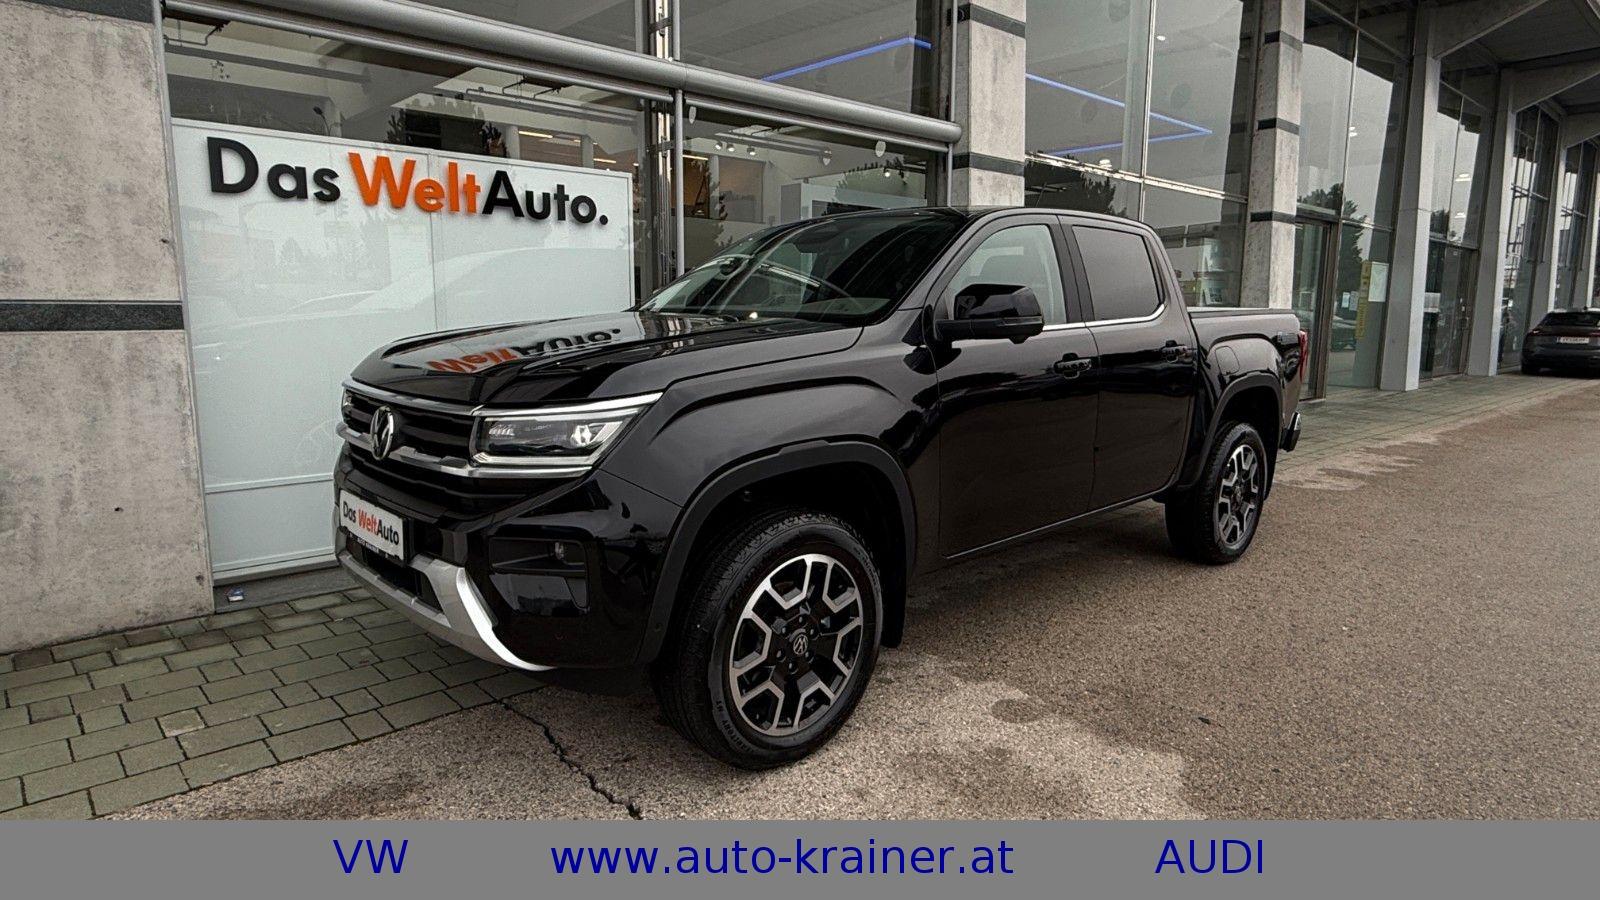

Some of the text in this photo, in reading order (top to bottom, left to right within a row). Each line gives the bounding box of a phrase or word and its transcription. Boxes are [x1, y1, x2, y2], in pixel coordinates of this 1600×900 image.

[207, 136, 341, 202] Das
[342, 500, 356, 523] Das
[358, 508, 400, 546] WeltAuto
